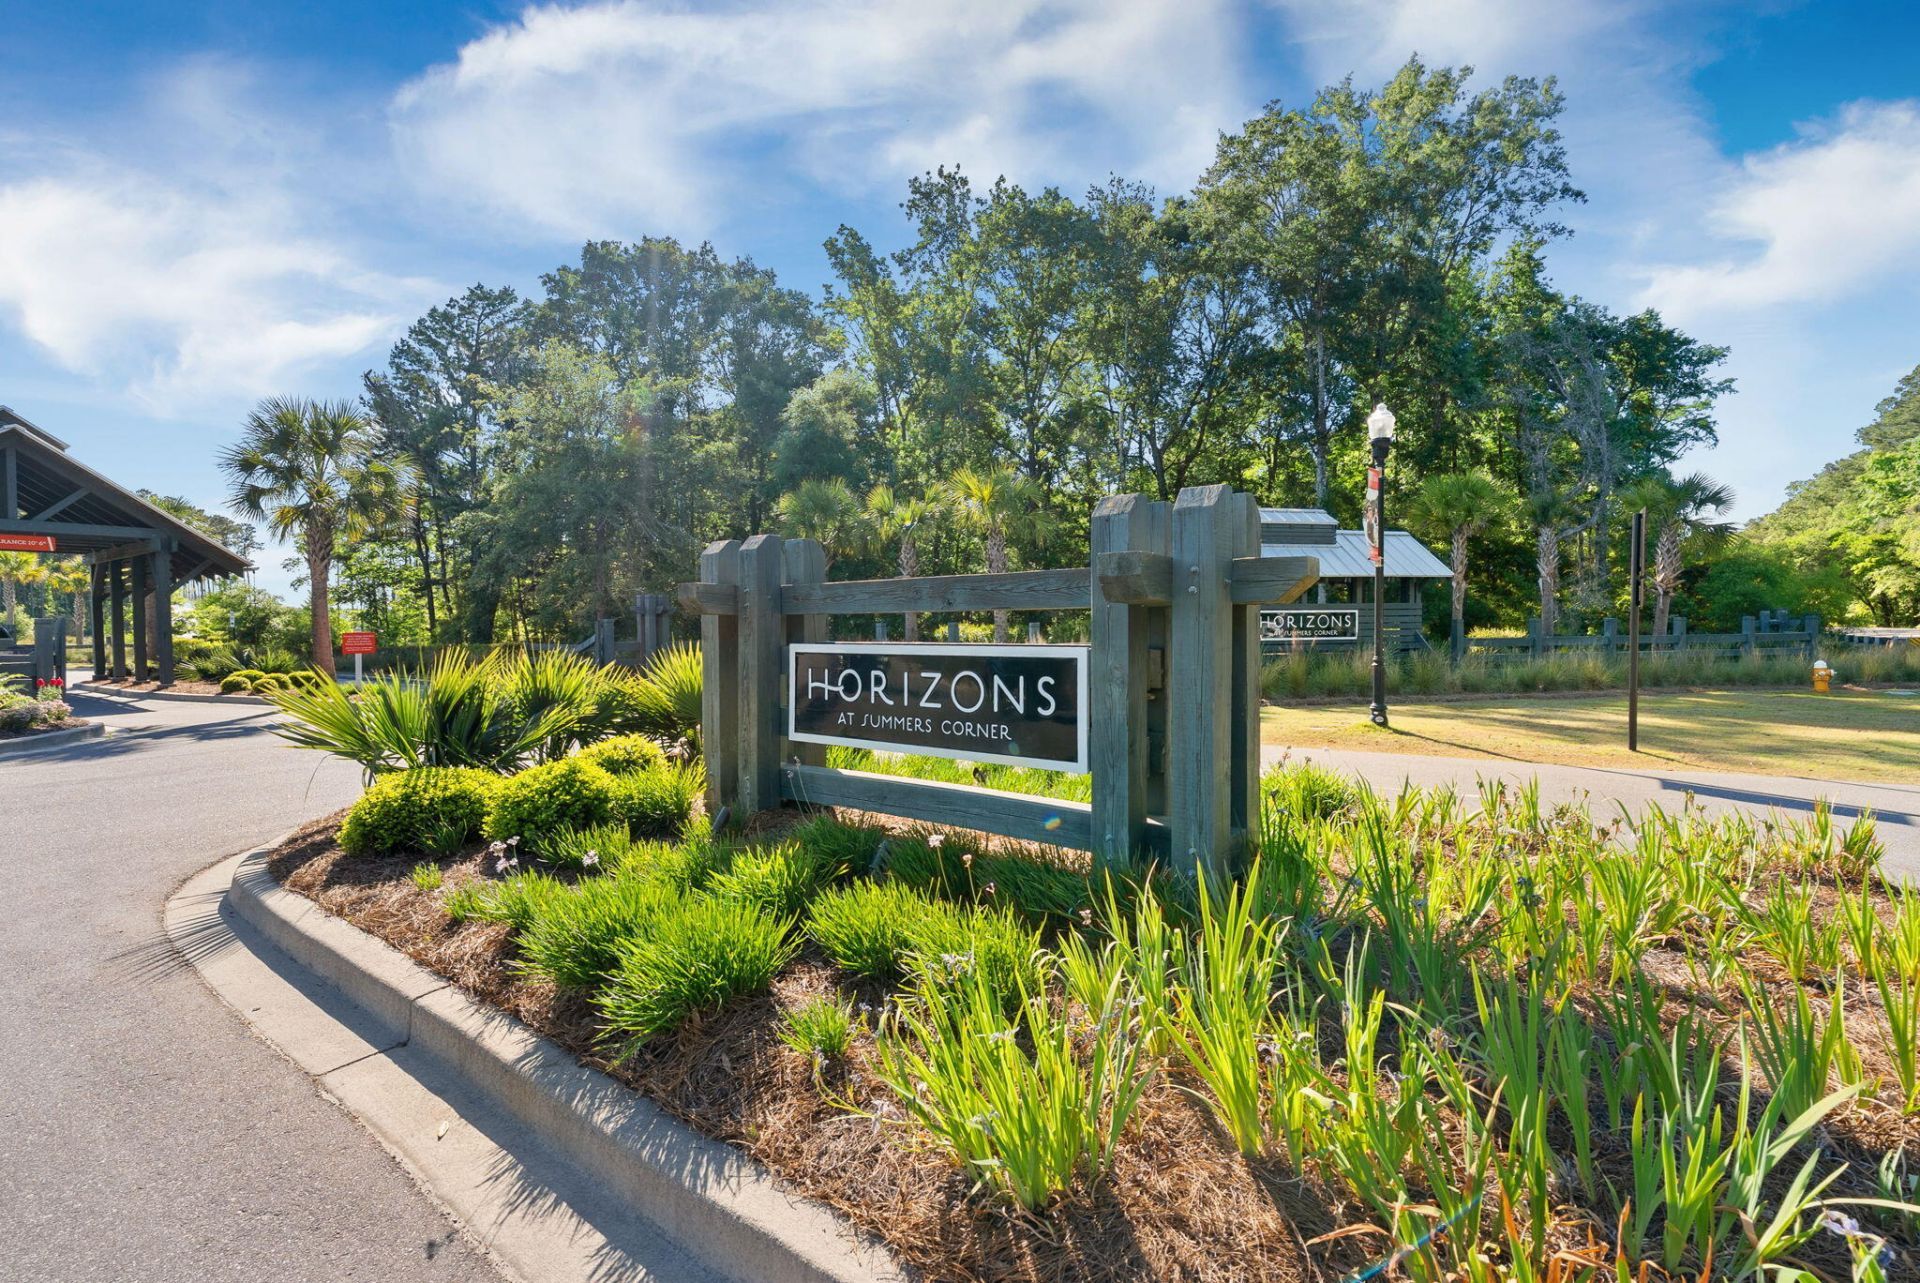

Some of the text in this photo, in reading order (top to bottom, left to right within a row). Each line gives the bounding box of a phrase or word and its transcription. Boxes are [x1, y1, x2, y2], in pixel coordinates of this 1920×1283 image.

[1260, 614, 1352, 628] HORIZONS
[808, 668, 1056, 716] HORIZONS
[837, 712, 1012, 741] AT SUMMERS CORNER
